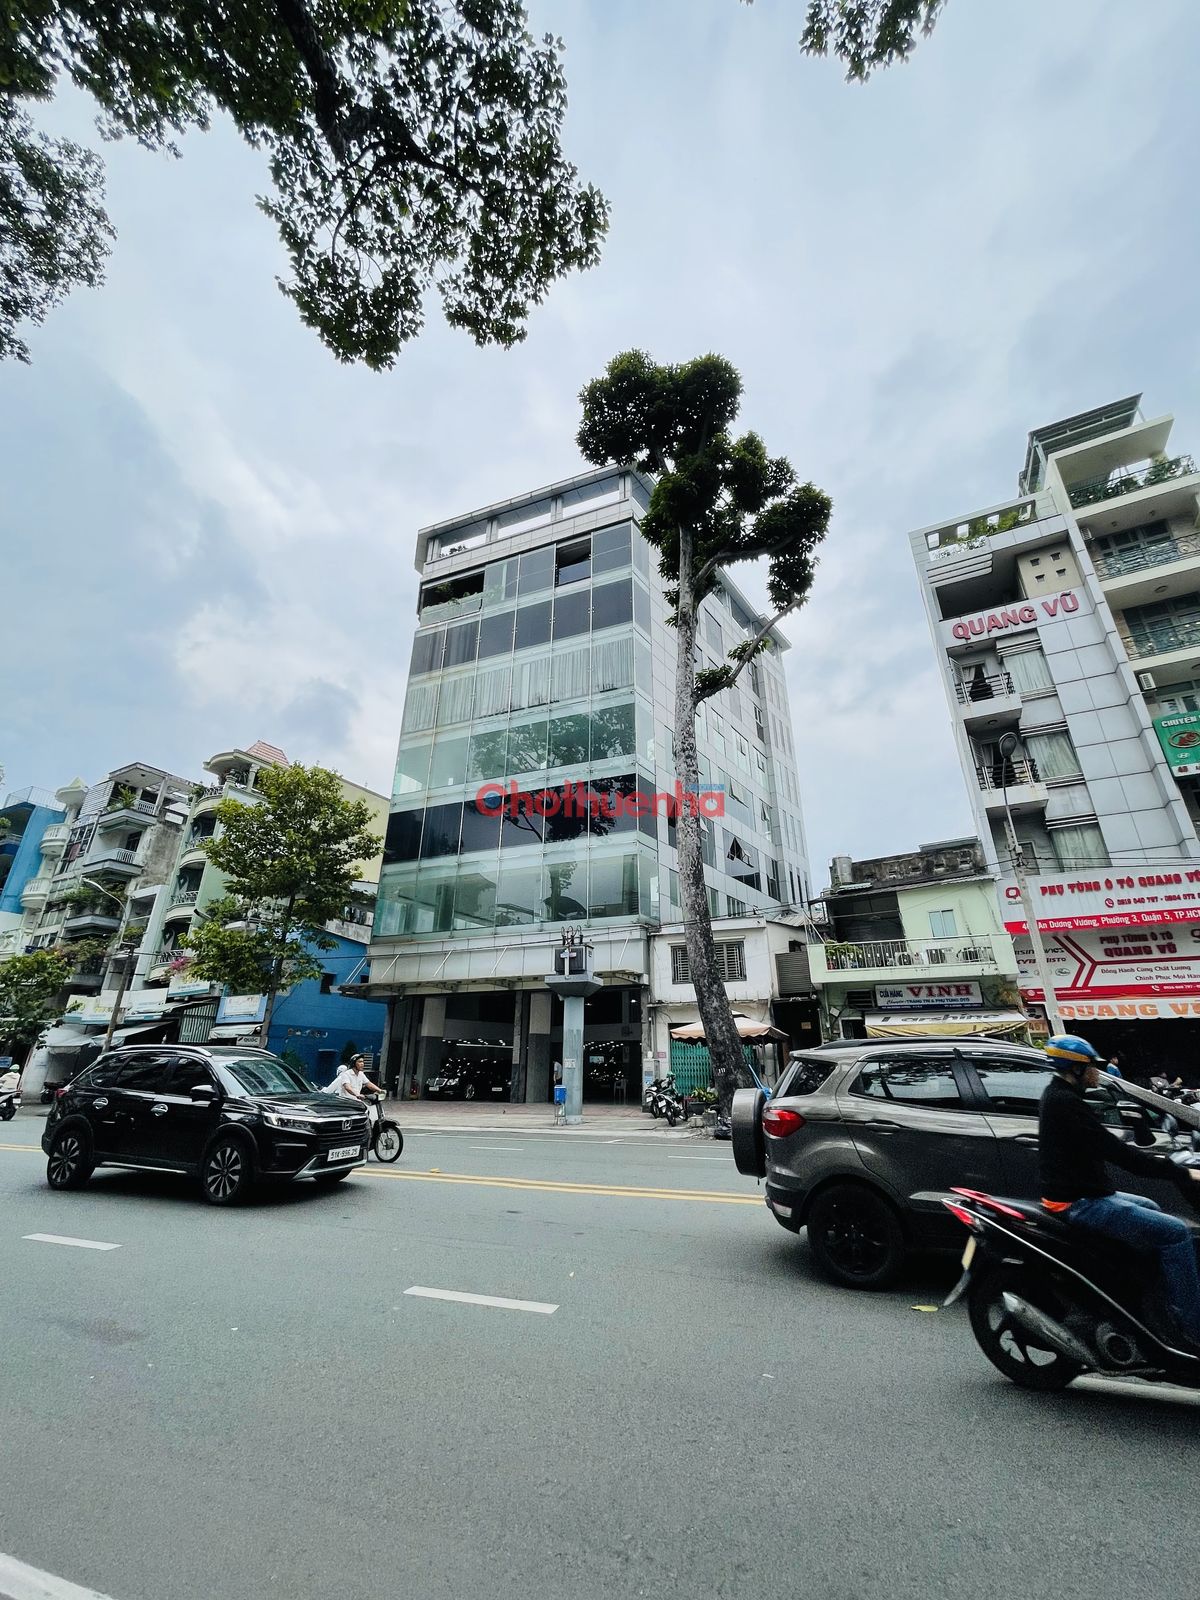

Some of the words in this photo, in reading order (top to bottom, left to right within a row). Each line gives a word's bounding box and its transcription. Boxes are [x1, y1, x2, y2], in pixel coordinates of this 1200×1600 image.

[952, 605, 1038, 640] QUANG
[1041, 590, 1080, 617] VŨ
[1040, 884, 1064, 896] PHỤ
[1067, 880, 1101, 894] TÙNG
[1104, 877, 1114, 890] Ô
[1116, 875, 1135, 889] TÔ
[1138, 873, 1182, 888] QUANG
[1131, 914, 1140, 923] 3,
[1141, 913, 1162, 922] Quận
[1163, 911, 1173, 920] 5,
[1104, 945, 1152, 957] QUANG
[1156, 942, 1177, 954] VŨ
[906, 984, 974, 998] VINH
[1057, 1002, 1159, 1018] QUANG
